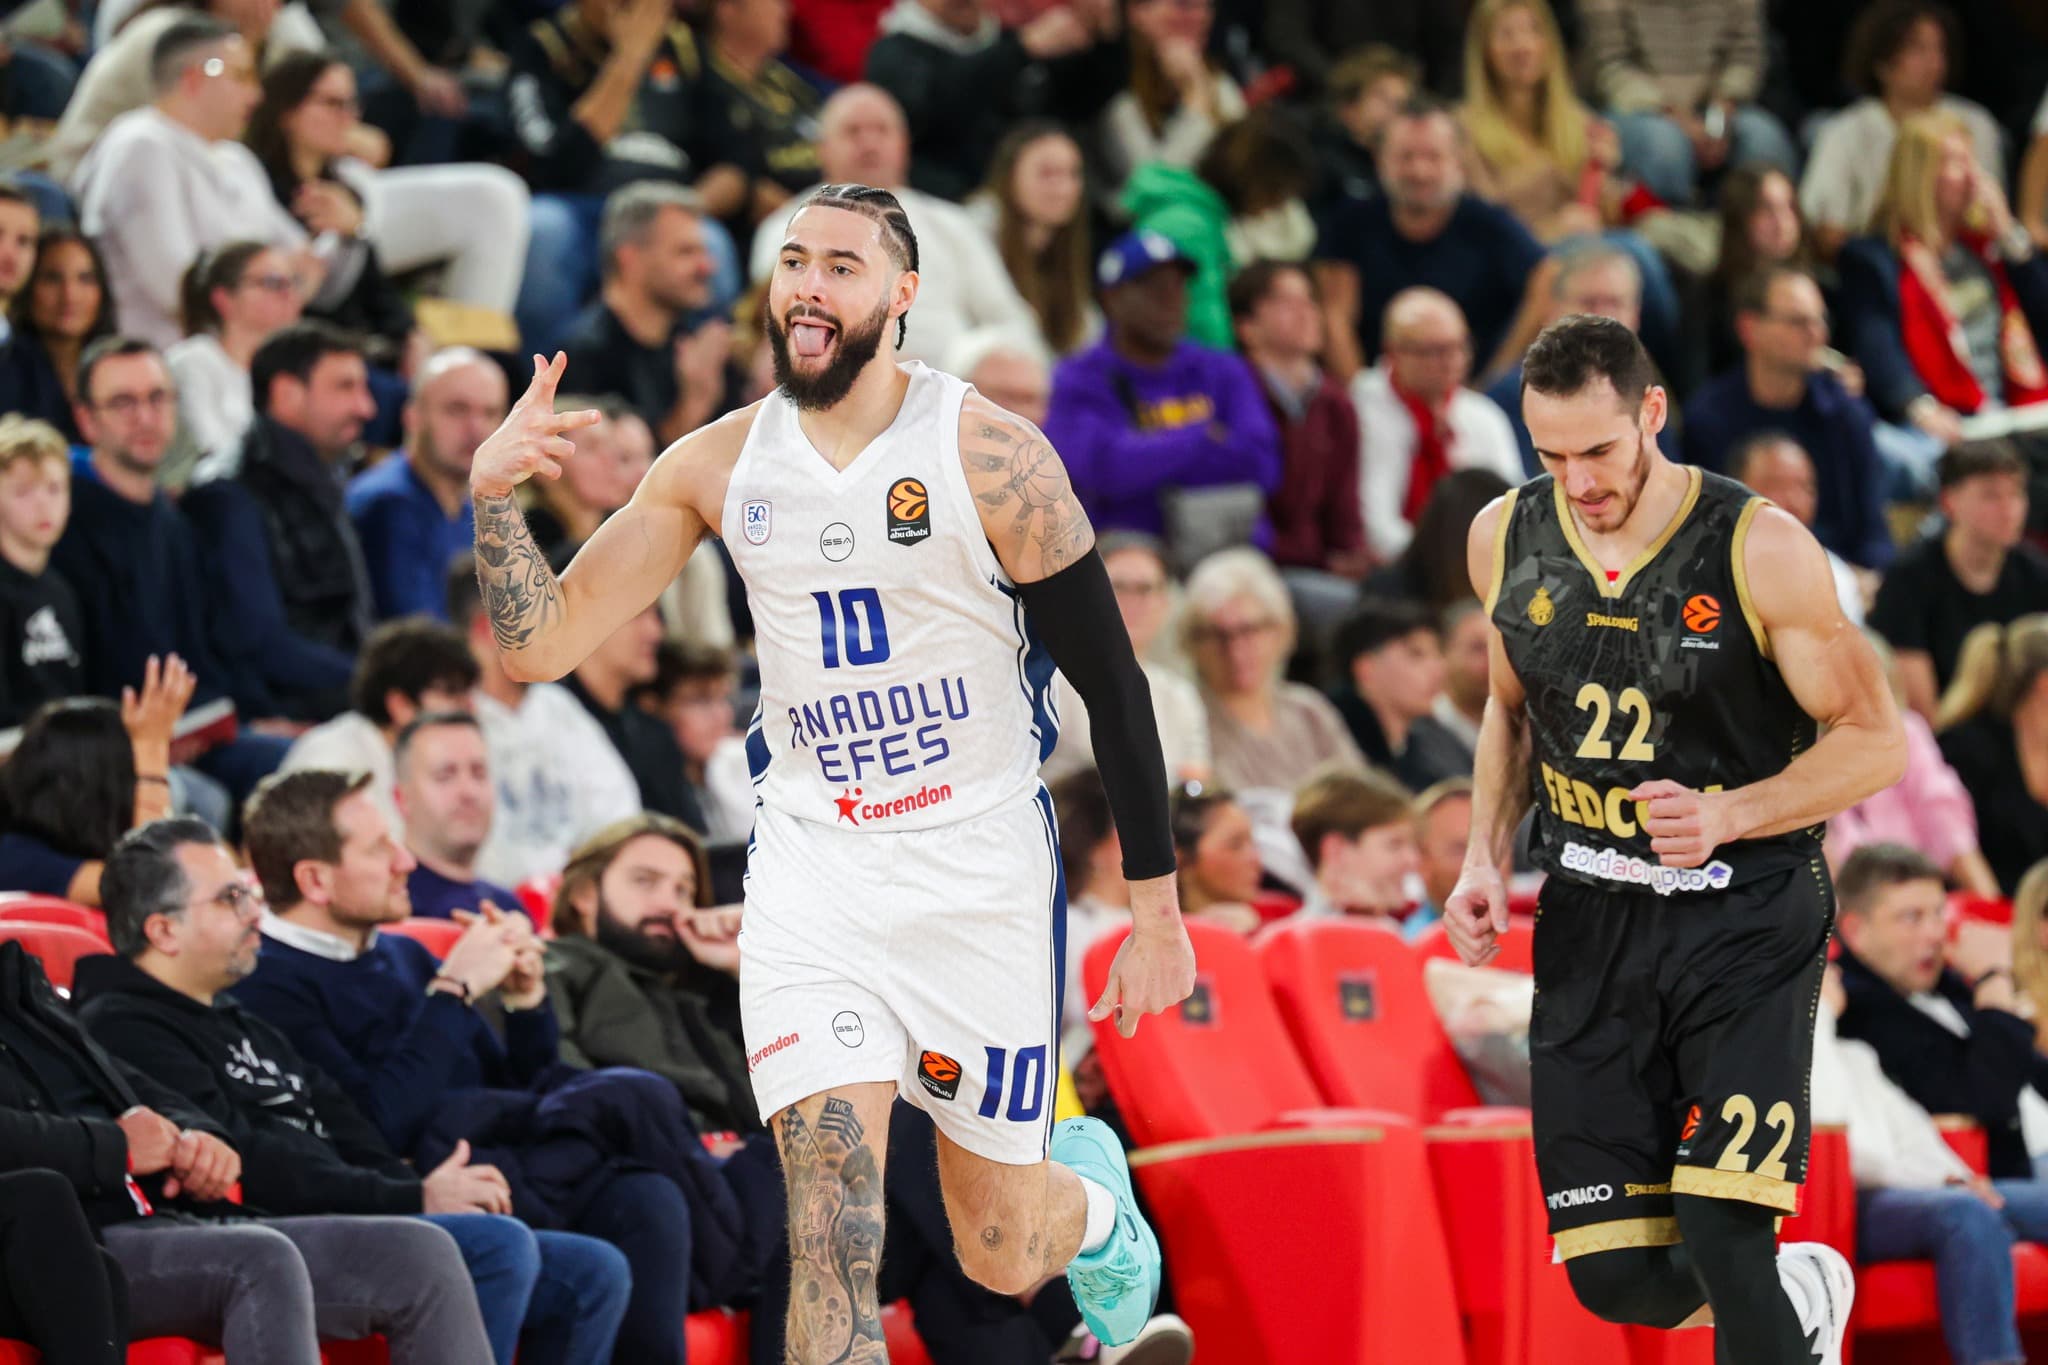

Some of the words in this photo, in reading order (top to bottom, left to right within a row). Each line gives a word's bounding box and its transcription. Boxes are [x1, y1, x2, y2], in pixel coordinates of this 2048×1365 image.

[810, 587, 891, 669] 10
[1586, 612, 1639, 632] SPALDING
[788, 676, 970, 750] ANADOLU
[1575, 682, 1655, 762] 22
[815, 722, 951, 783] EFES
[861, 783, 953, 821] corendon
[1541, 760, 1723, 839] FEDC
[978, 1044, 1047, 1122] 10
[1714, 1093, 1797, 1181] 22
